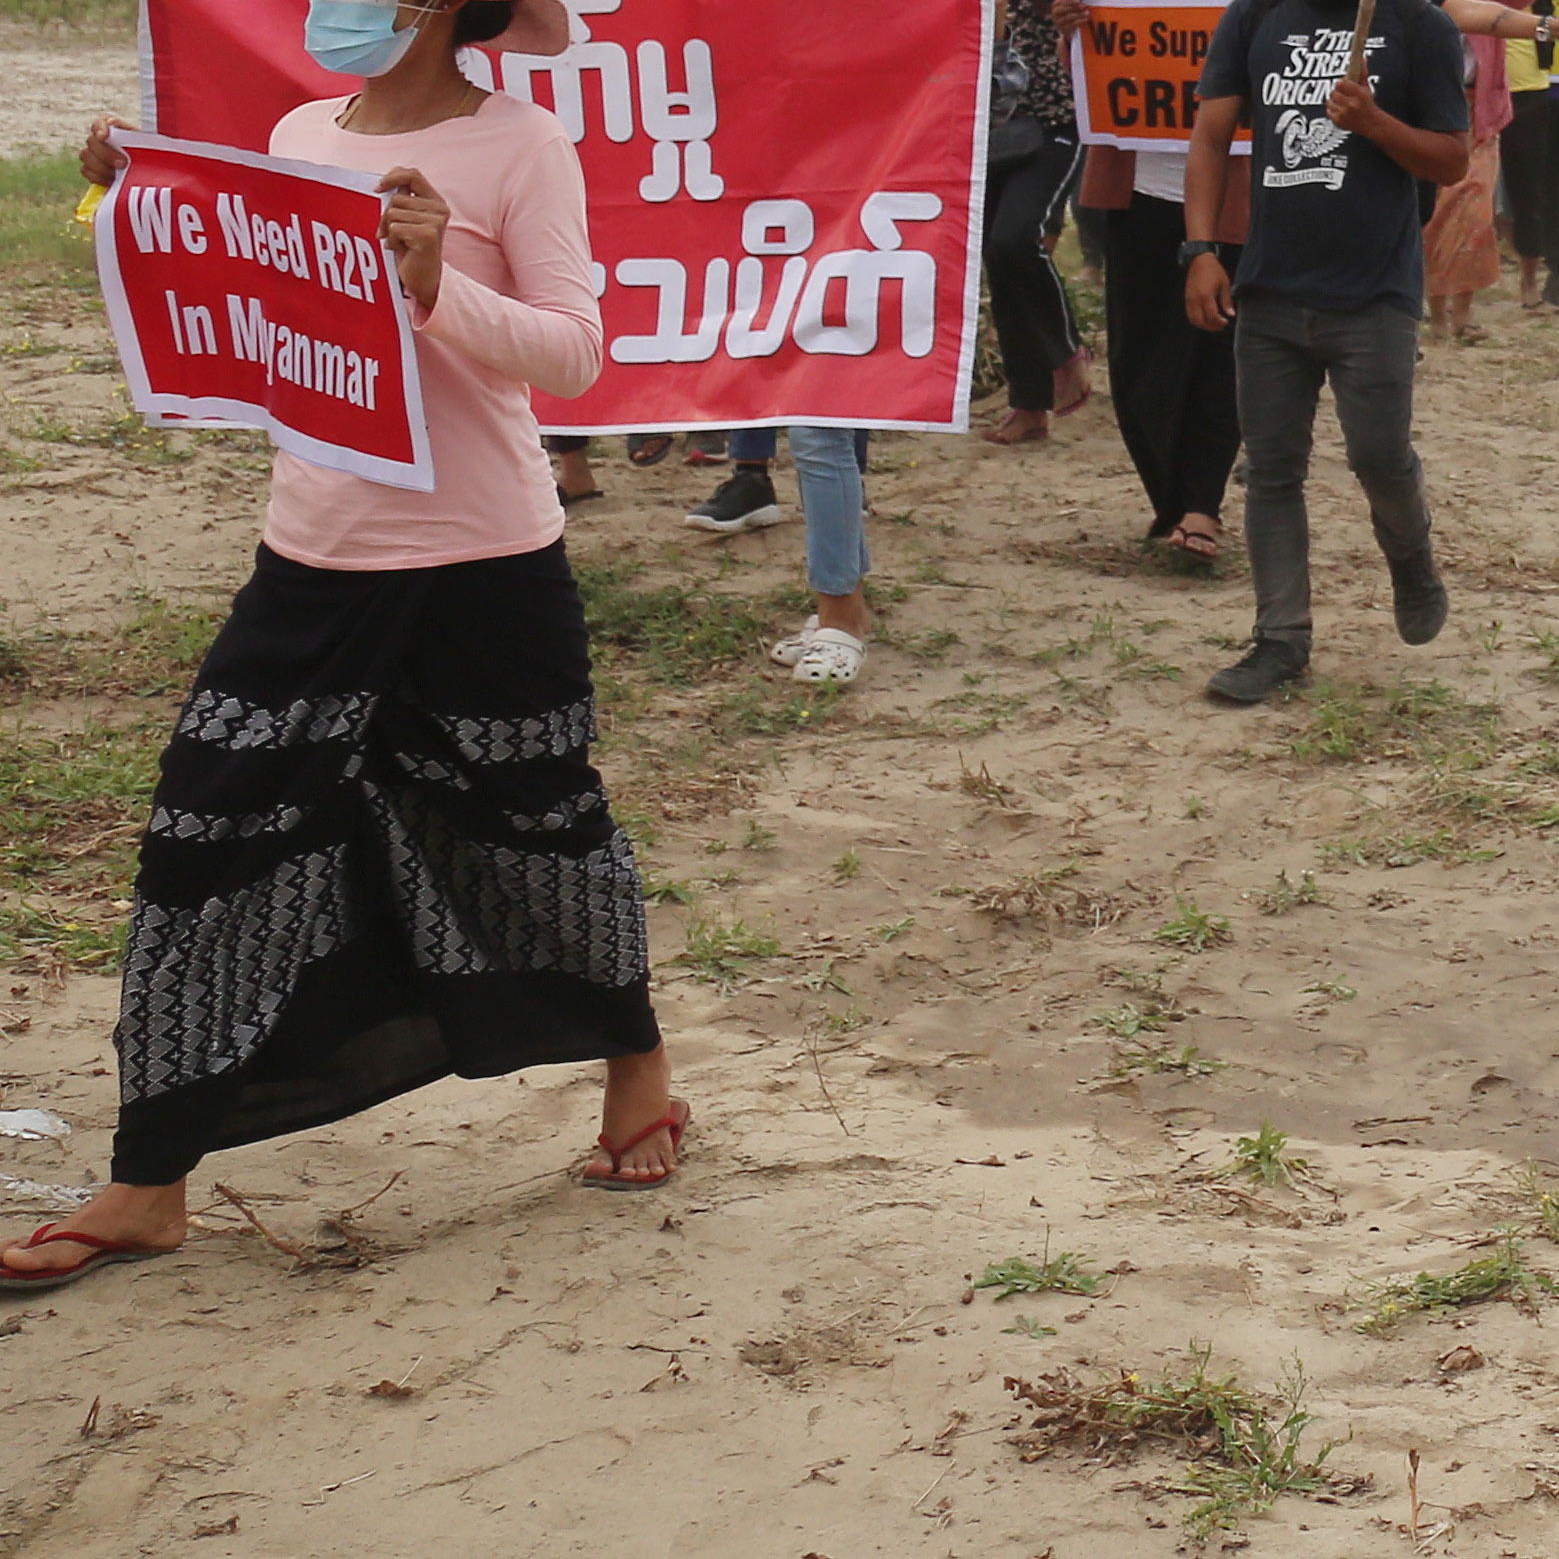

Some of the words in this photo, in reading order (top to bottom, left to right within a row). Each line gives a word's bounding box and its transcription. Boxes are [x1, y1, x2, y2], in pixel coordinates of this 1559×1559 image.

[1089, 21, 1136, 57] We
[1150, 21, 1210, 66] Sup
[1313, 28, 1356, 52] 7TH
[127, 186, 208, 254] We
[216, 192, 311, 280] Need
[311, 220, 379, 304] R2P
[164, 290, 218, 356] In
[226, 294, 380, 411] Myanmar
